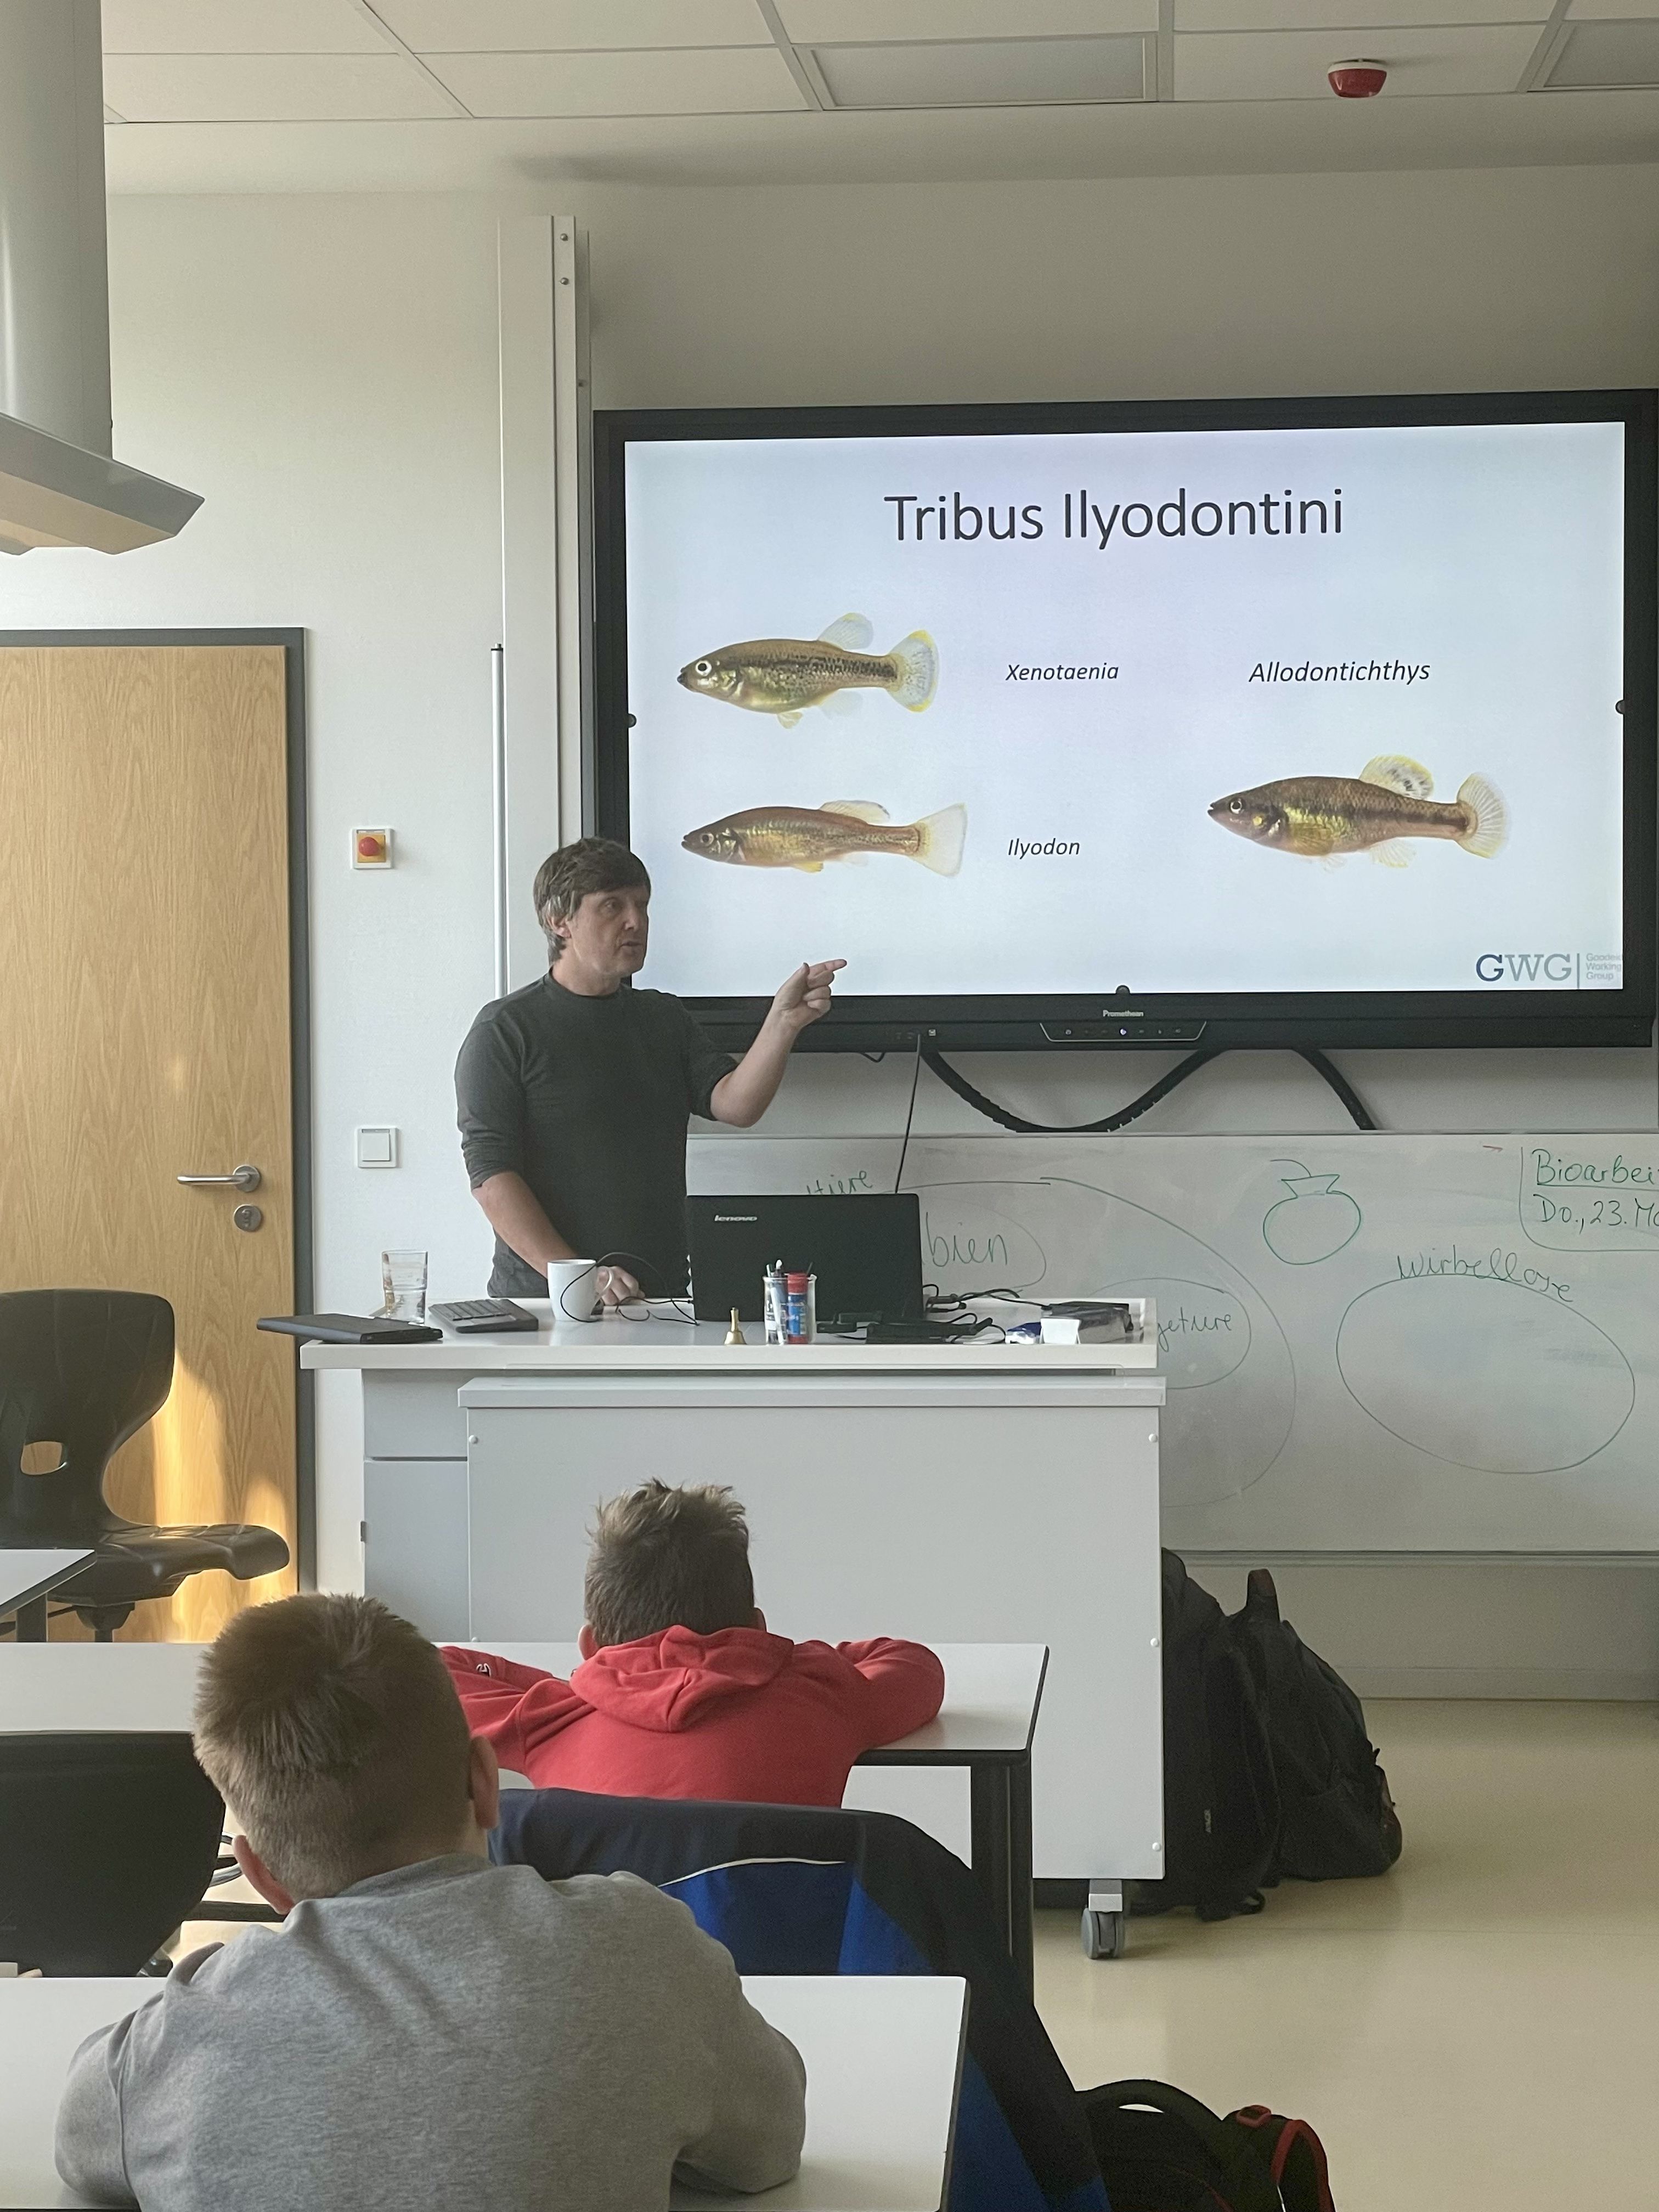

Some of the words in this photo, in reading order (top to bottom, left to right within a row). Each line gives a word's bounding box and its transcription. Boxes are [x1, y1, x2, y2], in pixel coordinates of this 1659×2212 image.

[884, 492, 1043, 541] Tribus
[1064, 488, 1342, 550] Ilyodontini
[1005, 662, 1119, 681] Xenotaenia
[1248, 659, 1430, 685] Allodontichthys
[1008, 838, 1080, 860] Ilyodon
[1476, 953, 1572, 982] GWG
[1586, 972, 1613, 980] Group
[1532, 1148, 1659, 1185] Bioarbei
[922, 1211, 1008, 1267] bien
